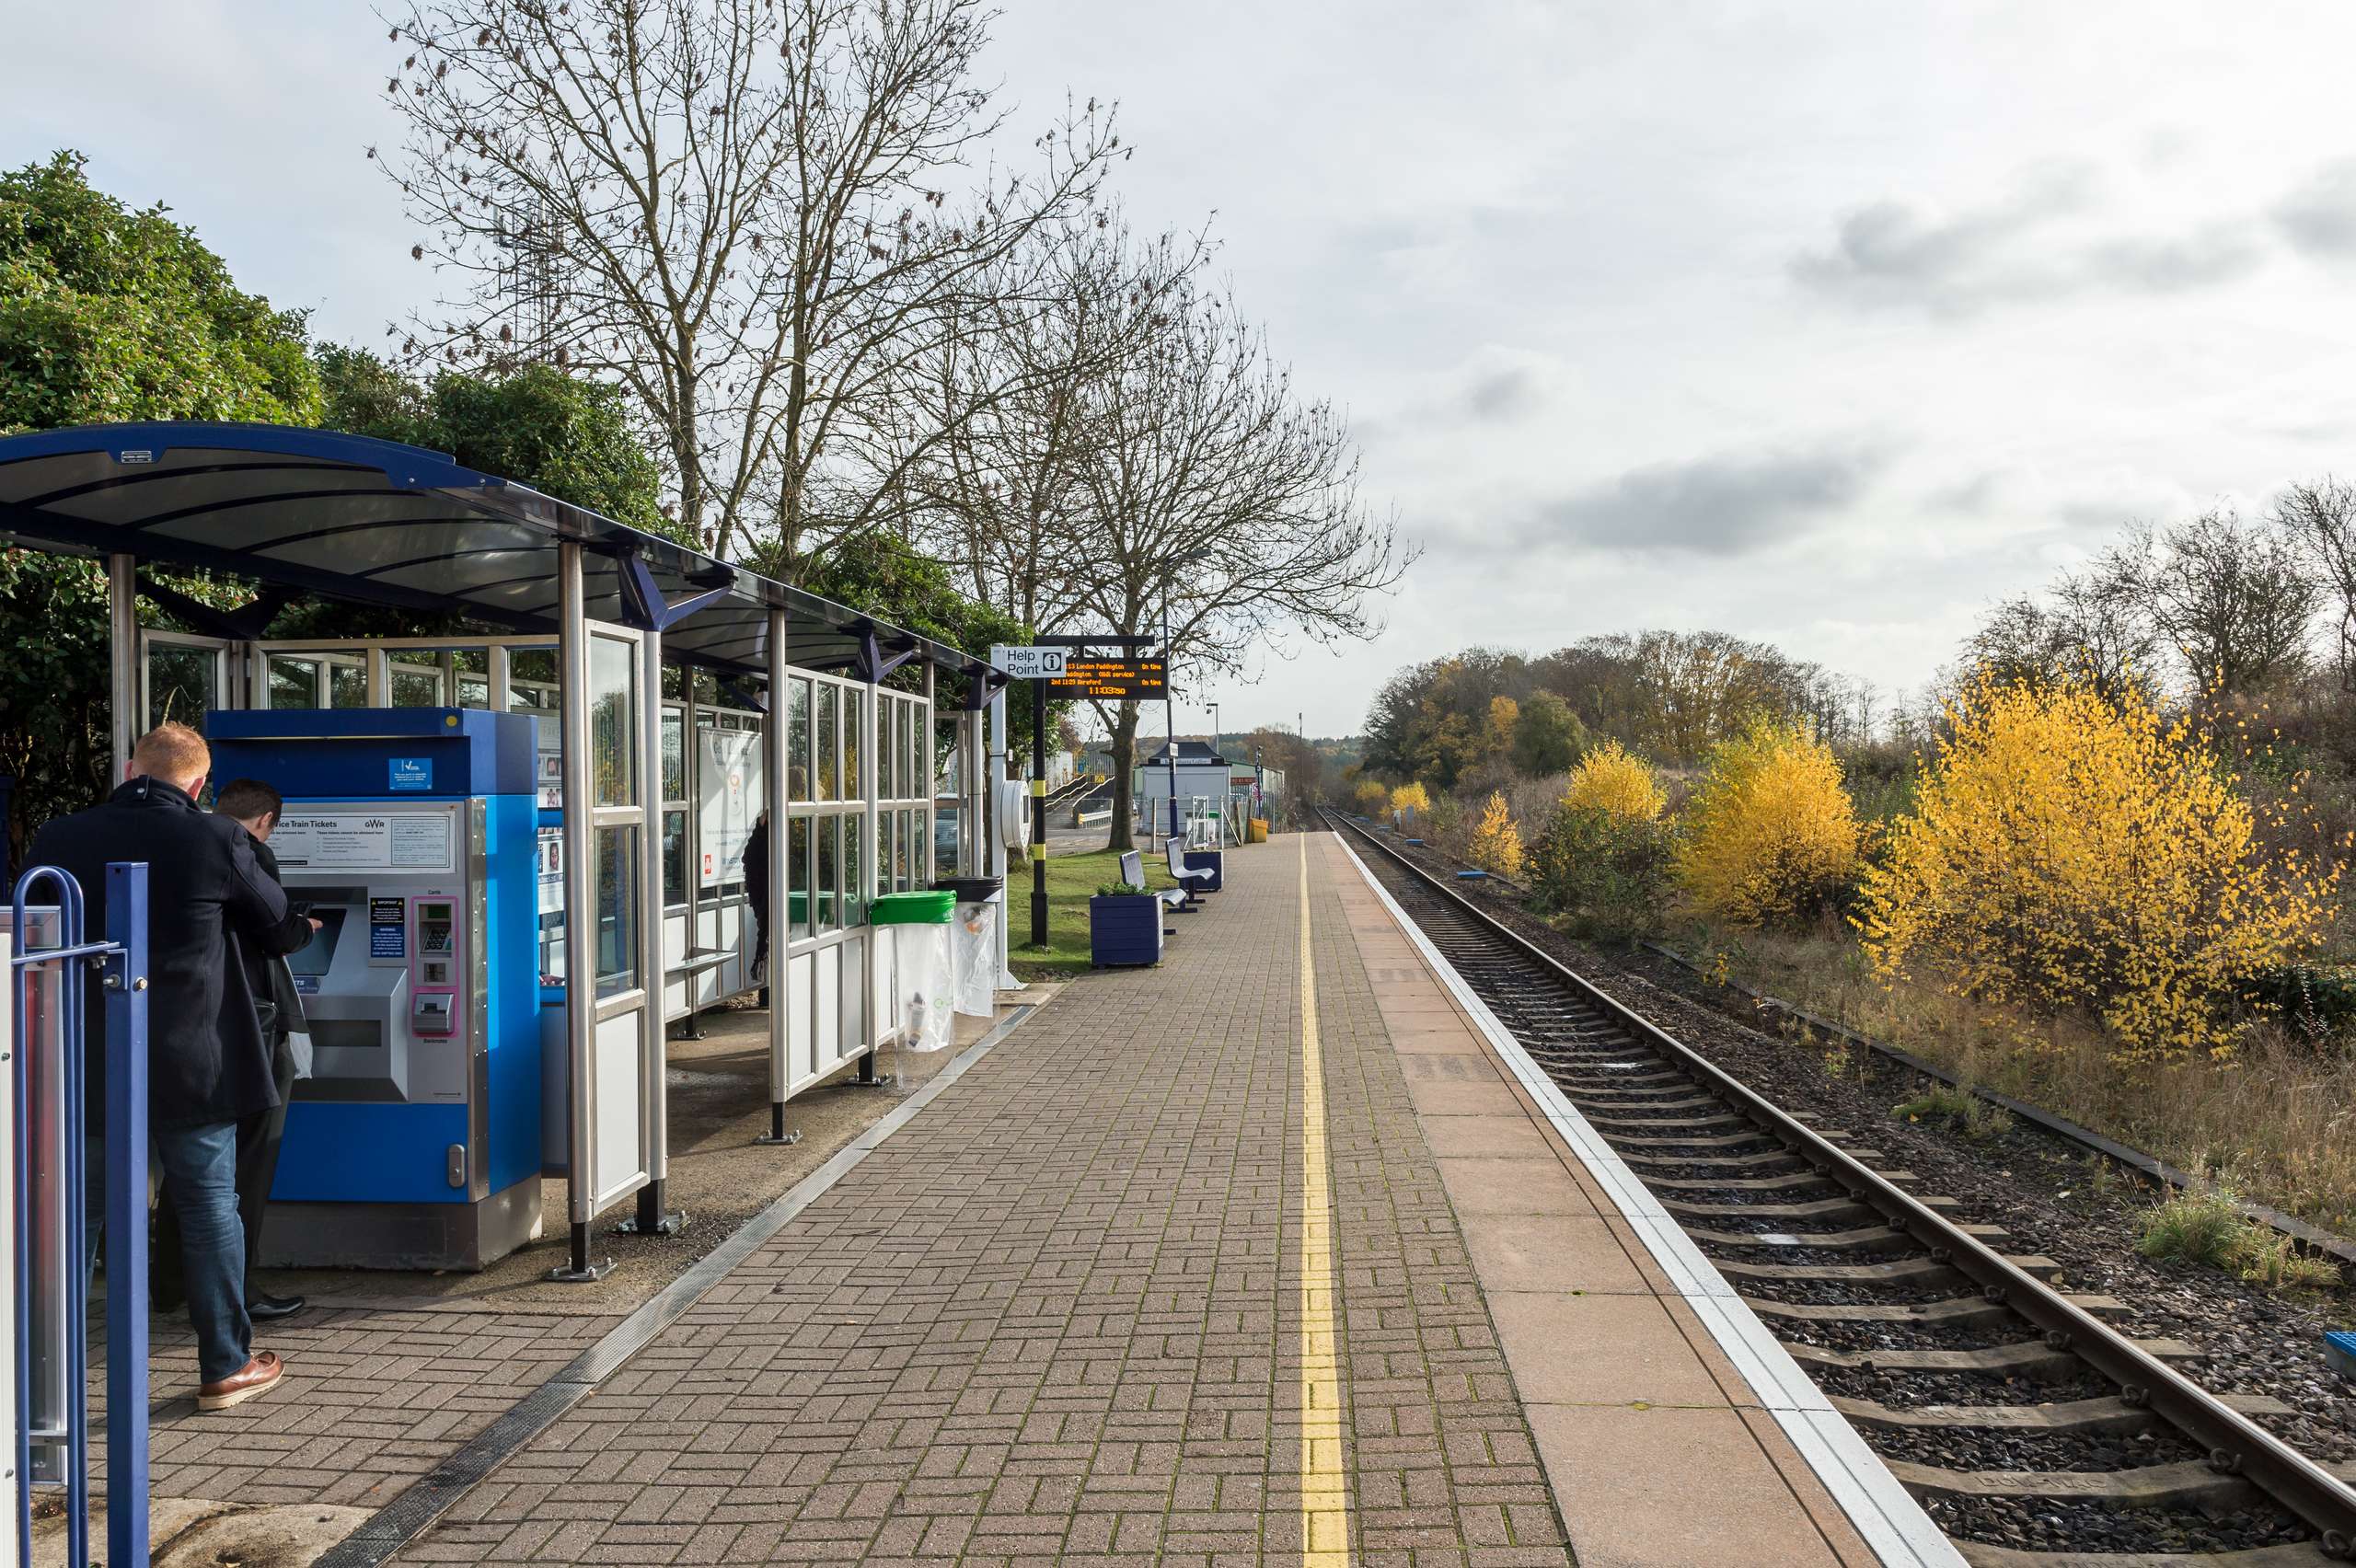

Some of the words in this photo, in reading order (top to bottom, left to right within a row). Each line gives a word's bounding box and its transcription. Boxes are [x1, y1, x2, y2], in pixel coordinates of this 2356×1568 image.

[1008, 650, 1035, 663] Help
[1008, 663, 1039, 674] Point
[290, 820, 309, 828] Train
[309, 820, 338, 828] Tickets
[364, 818, 385, 829] GWR
